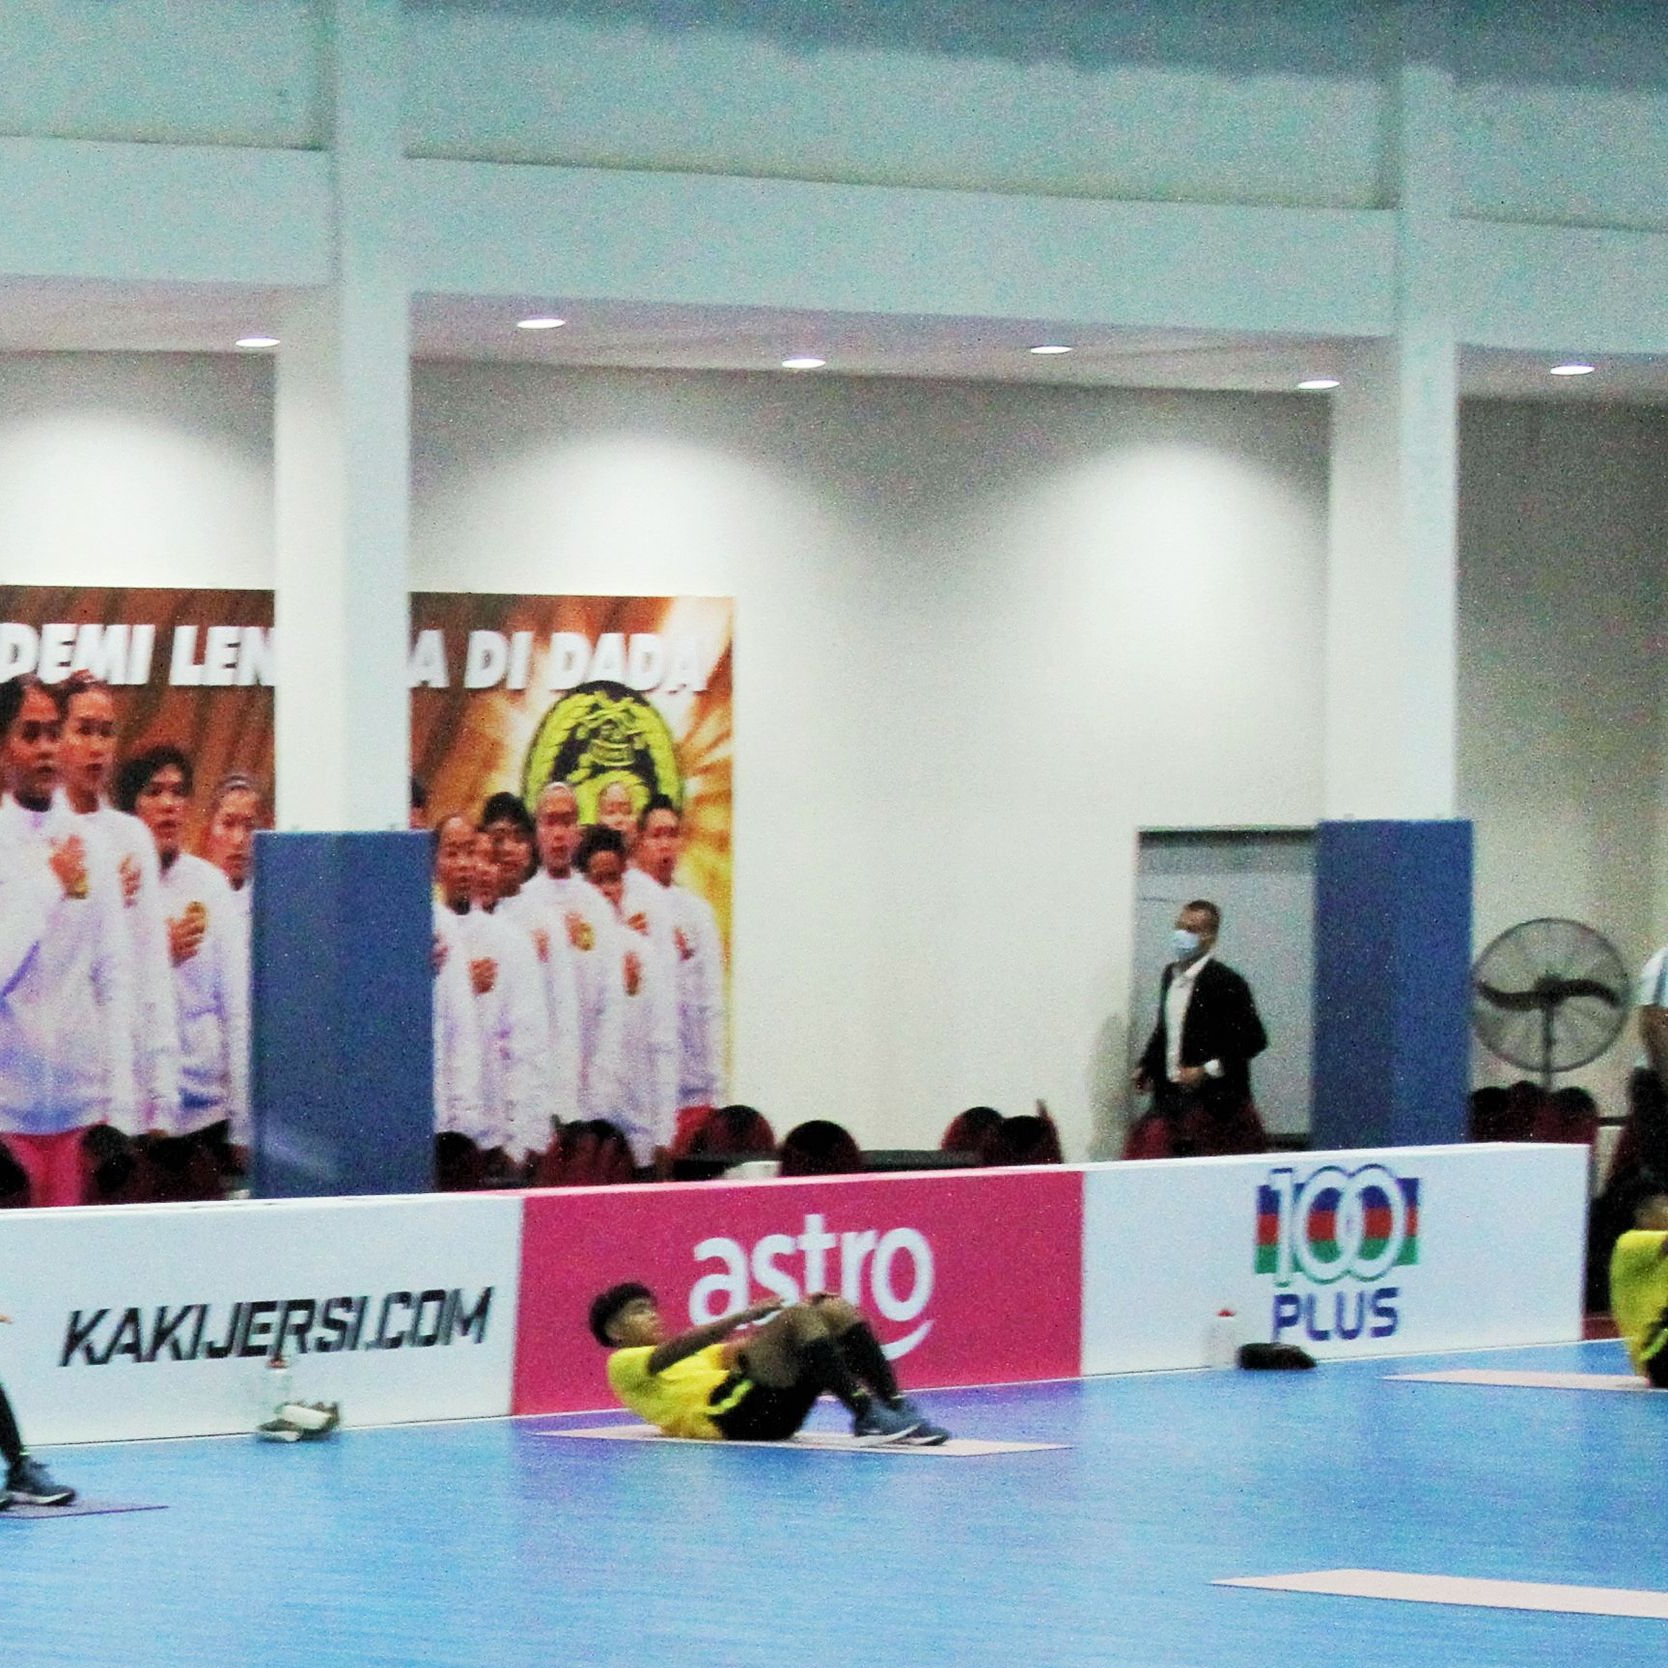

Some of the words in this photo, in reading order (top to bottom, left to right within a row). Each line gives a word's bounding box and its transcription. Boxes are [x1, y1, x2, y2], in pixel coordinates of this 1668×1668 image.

[465, 630, 534, 690] DI
[550, 630, 709, 692] DADA
[1269, 1163, 1406, 1288] 100
[688, 1213, 935, 1330] astro
[57, 1285, 495, 1368] KAKIJERSI.COM
[1273, 1287, 1400, 1343] PLUS
